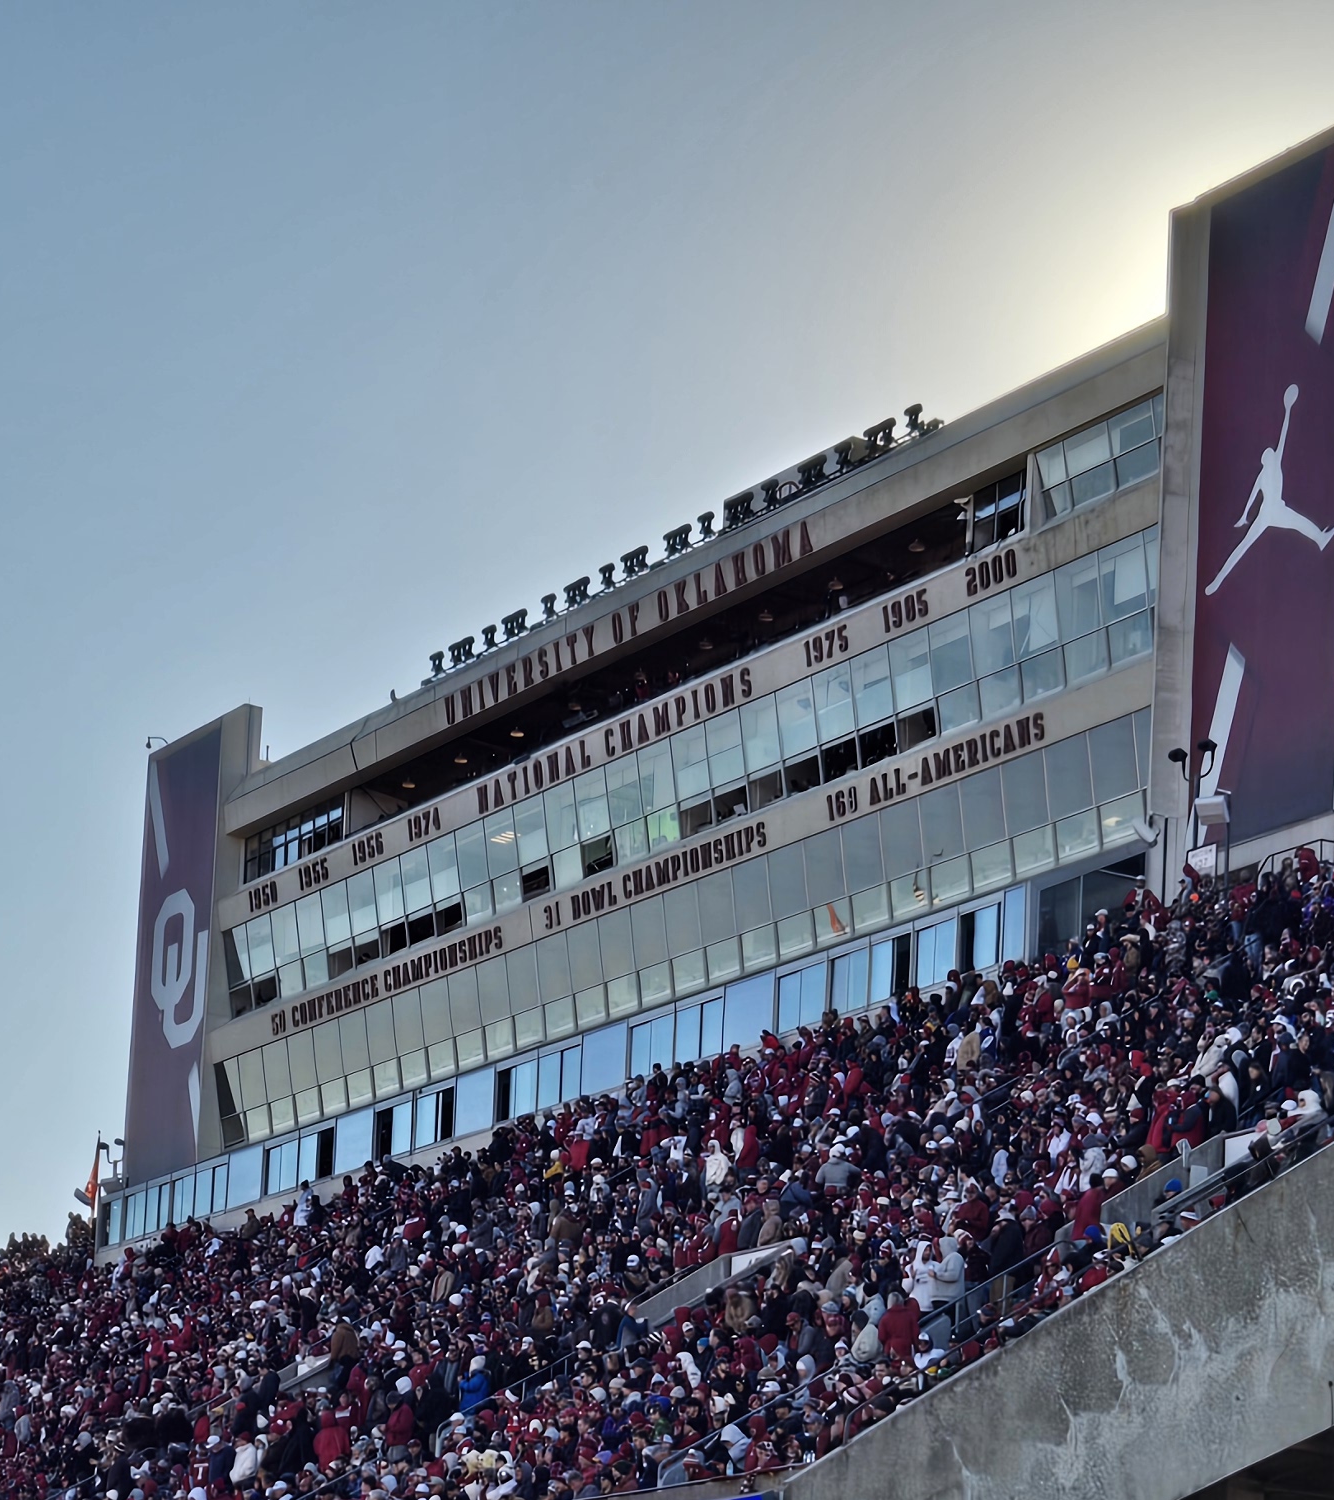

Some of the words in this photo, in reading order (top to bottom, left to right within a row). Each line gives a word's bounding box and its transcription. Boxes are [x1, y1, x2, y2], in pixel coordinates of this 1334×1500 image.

[444, 624, 596, 725] UNIVERSITY
[612, 603, 640, 644] OF
[657, 521, 814, 622] OKLAHOMA
[299, 857, 329, 891] 1955
[351, 832, 384, 866] 1956
[407, 807, 441, 842] 1974
[477, 740, 592, 815] NATIONAL
[604, 667, 753, 757] CHAMPIONS
[803, 624, 849, 667] 1975
[965, 549, 1017, 597] 2000
[869, 712, 1046, 806] ALL-AMERICANS
[543, 901, 561, 930] 31
[570, 881, 617, 920] BOWL
[622, 822, 768, 899] CHAMPIONSHIPS
[271, 1009, 287, 1036] 50
[291, 975, 379, 1028] CONFERENCE
[383, 926, 504, 992] CHAMPIONSHIPS
